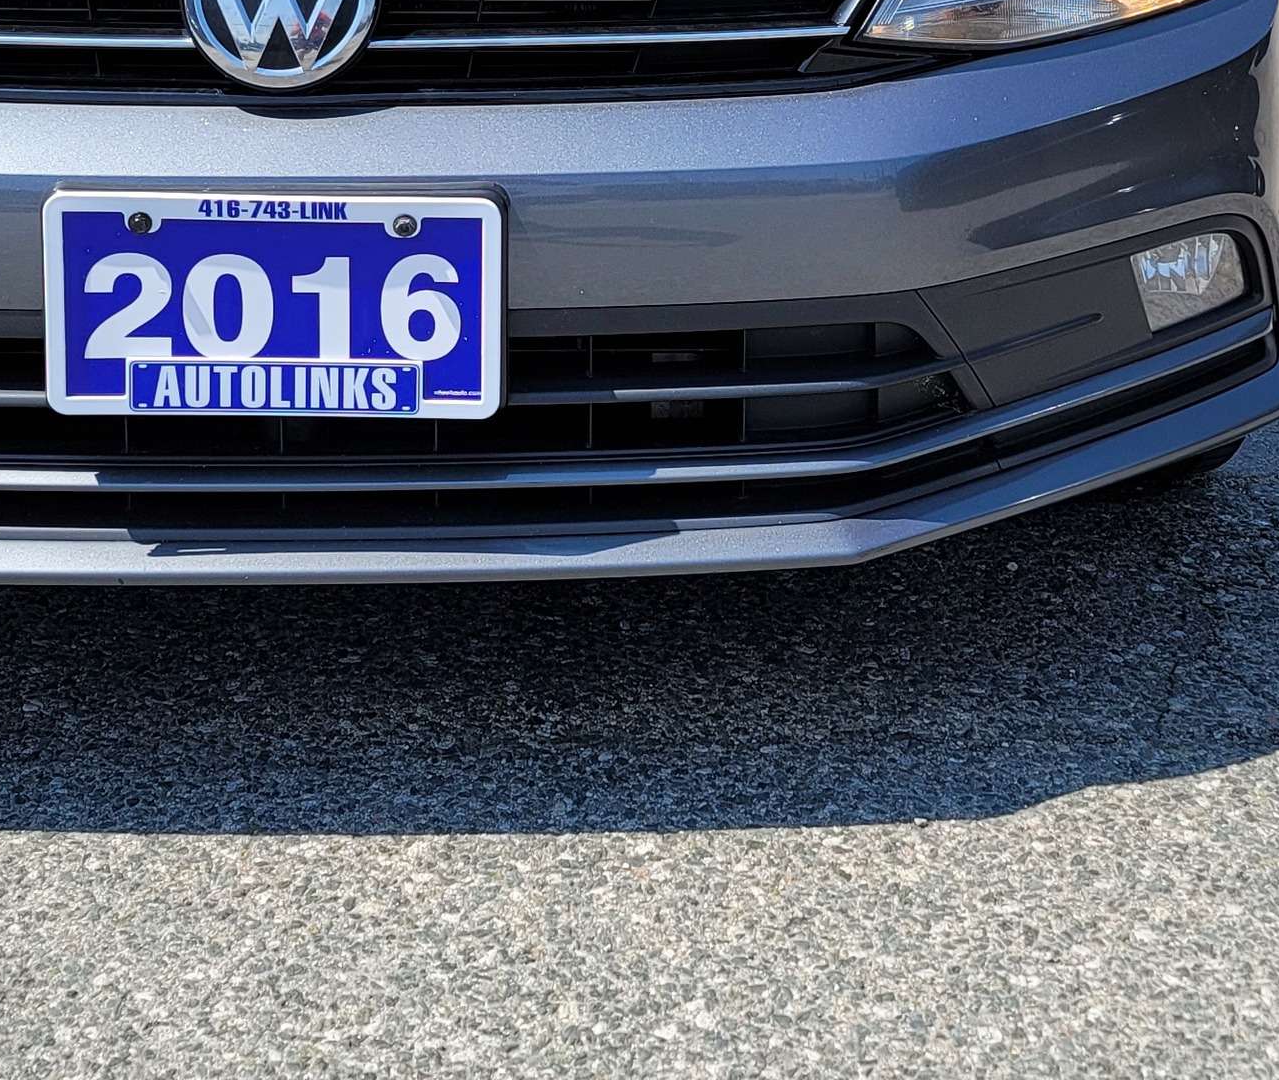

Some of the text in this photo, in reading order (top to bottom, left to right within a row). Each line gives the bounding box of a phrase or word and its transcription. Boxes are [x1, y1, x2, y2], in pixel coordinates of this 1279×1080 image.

[198, 199, 348, 220] 416-743-LINK
[83, 252, 462, 362] 2016
[152, 365, 398, 411] AUTOLINKS
